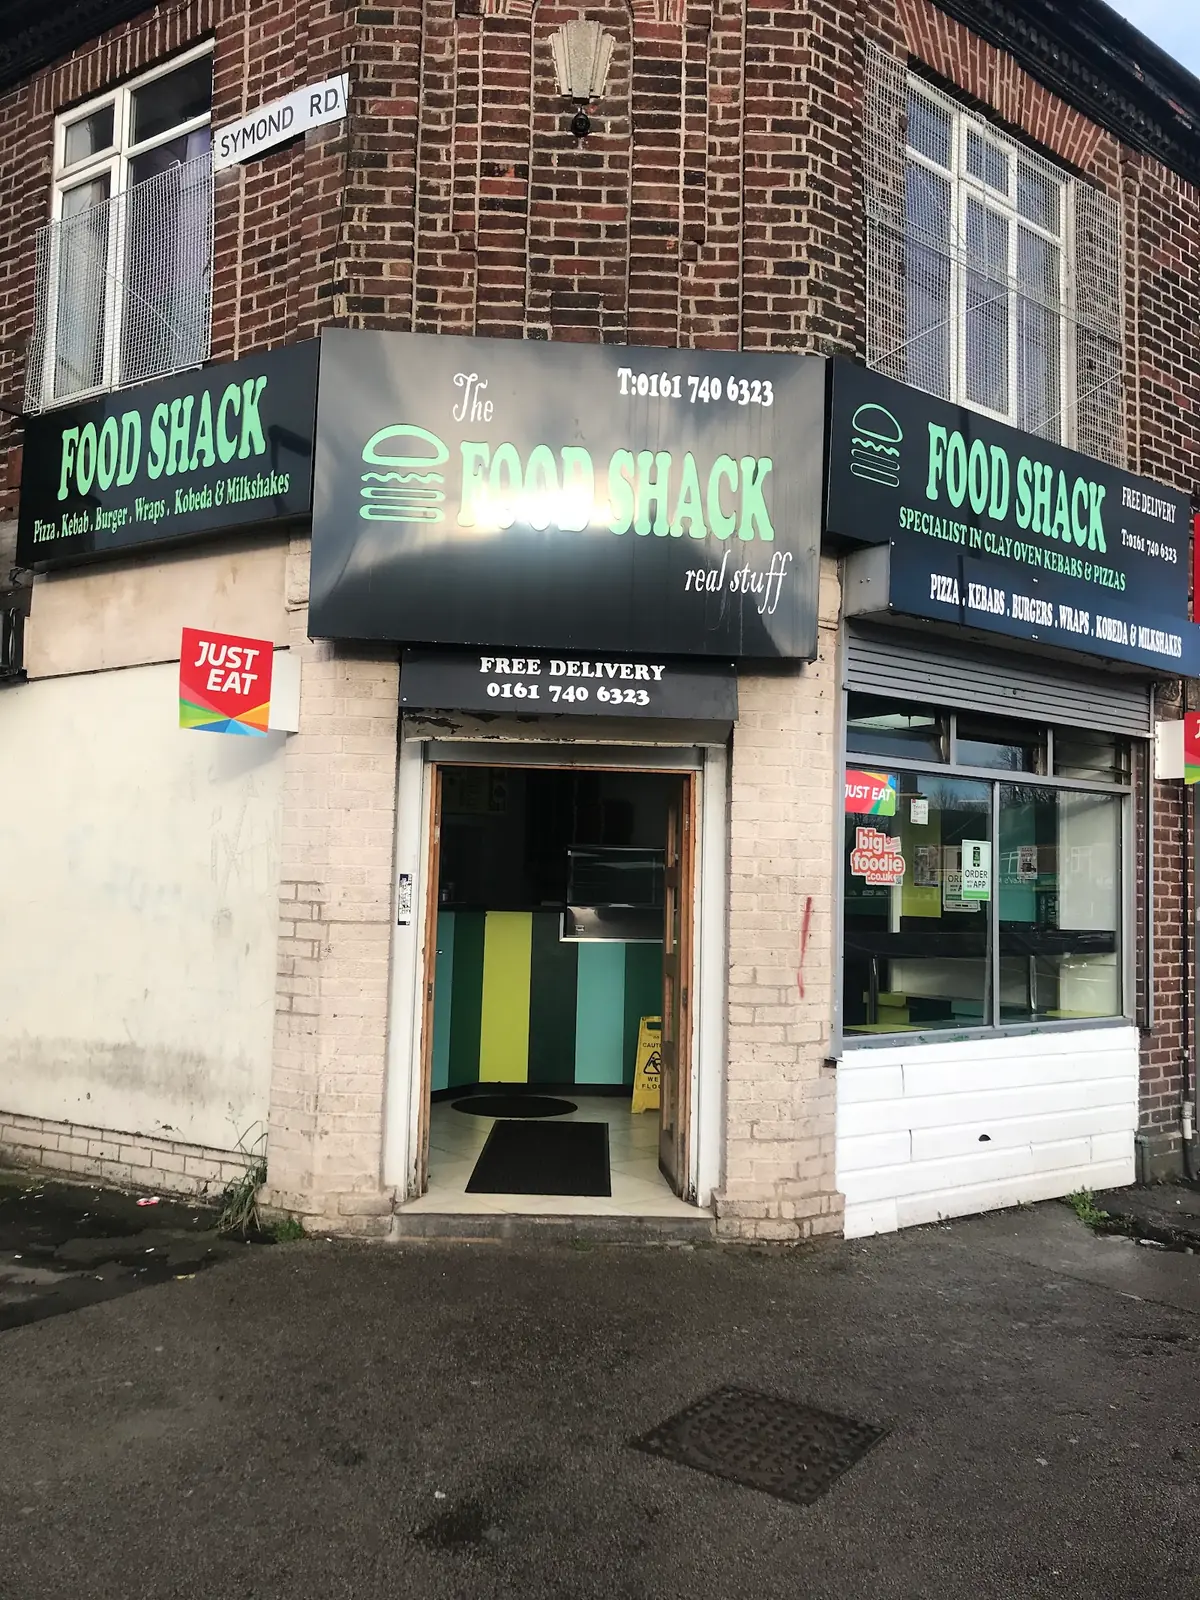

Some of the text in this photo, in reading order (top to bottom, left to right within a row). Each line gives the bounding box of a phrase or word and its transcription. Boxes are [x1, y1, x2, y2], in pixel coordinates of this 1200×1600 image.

[220, 105, 294, 157] SYMOND
[453, 372, 494, 422] The
[687, 375, 721, 403] 740
[726, 376, 774, 407] 6323
[57, 375, 268, 500] FOOD SHACK
[457, 440, 775, 541] FOOD SHACK
[926, 421, 1107, 554] FOOD SHACK
[33, 470, 290, 543] Pizza Kebab Burger Wraps Kobeda & Milkshakes
[1122, 486, 1176, 523] FREE DELIVERY
[899, 506, 1126, 591] SPECIALIST IN CLAY OVEN KEBABS & PIZZAS
[1147, 539, 1159, 556] 740
[1160, 543, 1177, 564] 6323
[684, 549, 792, 614] real stuff
[930, 573, 960, 605] PIZZA
[968, 582, 1005, 615] KEBABS
[1012, 593, 1054, 627] BURGERS
[1059, 604, 1089, 635] WRAPS
[1095, 615, 1128, 645] KOBEDA
[1138, 625, 1182, 658] MILKSHAKES
[194, 641, 260, 670] JUST
[479, 657, 666, 681] FREE DELIVERY
[206, 668, 258, 695] EAT
[486, 682, 651, 706] 0161 740 6323
[844, 784, 893, 801] JUST EAT
[860, 832, 883, 854] big
[853, 852, 902, 871] foodie
[964, 869, 988, 878] ORDER
[973, 880, 986, 888] APP
